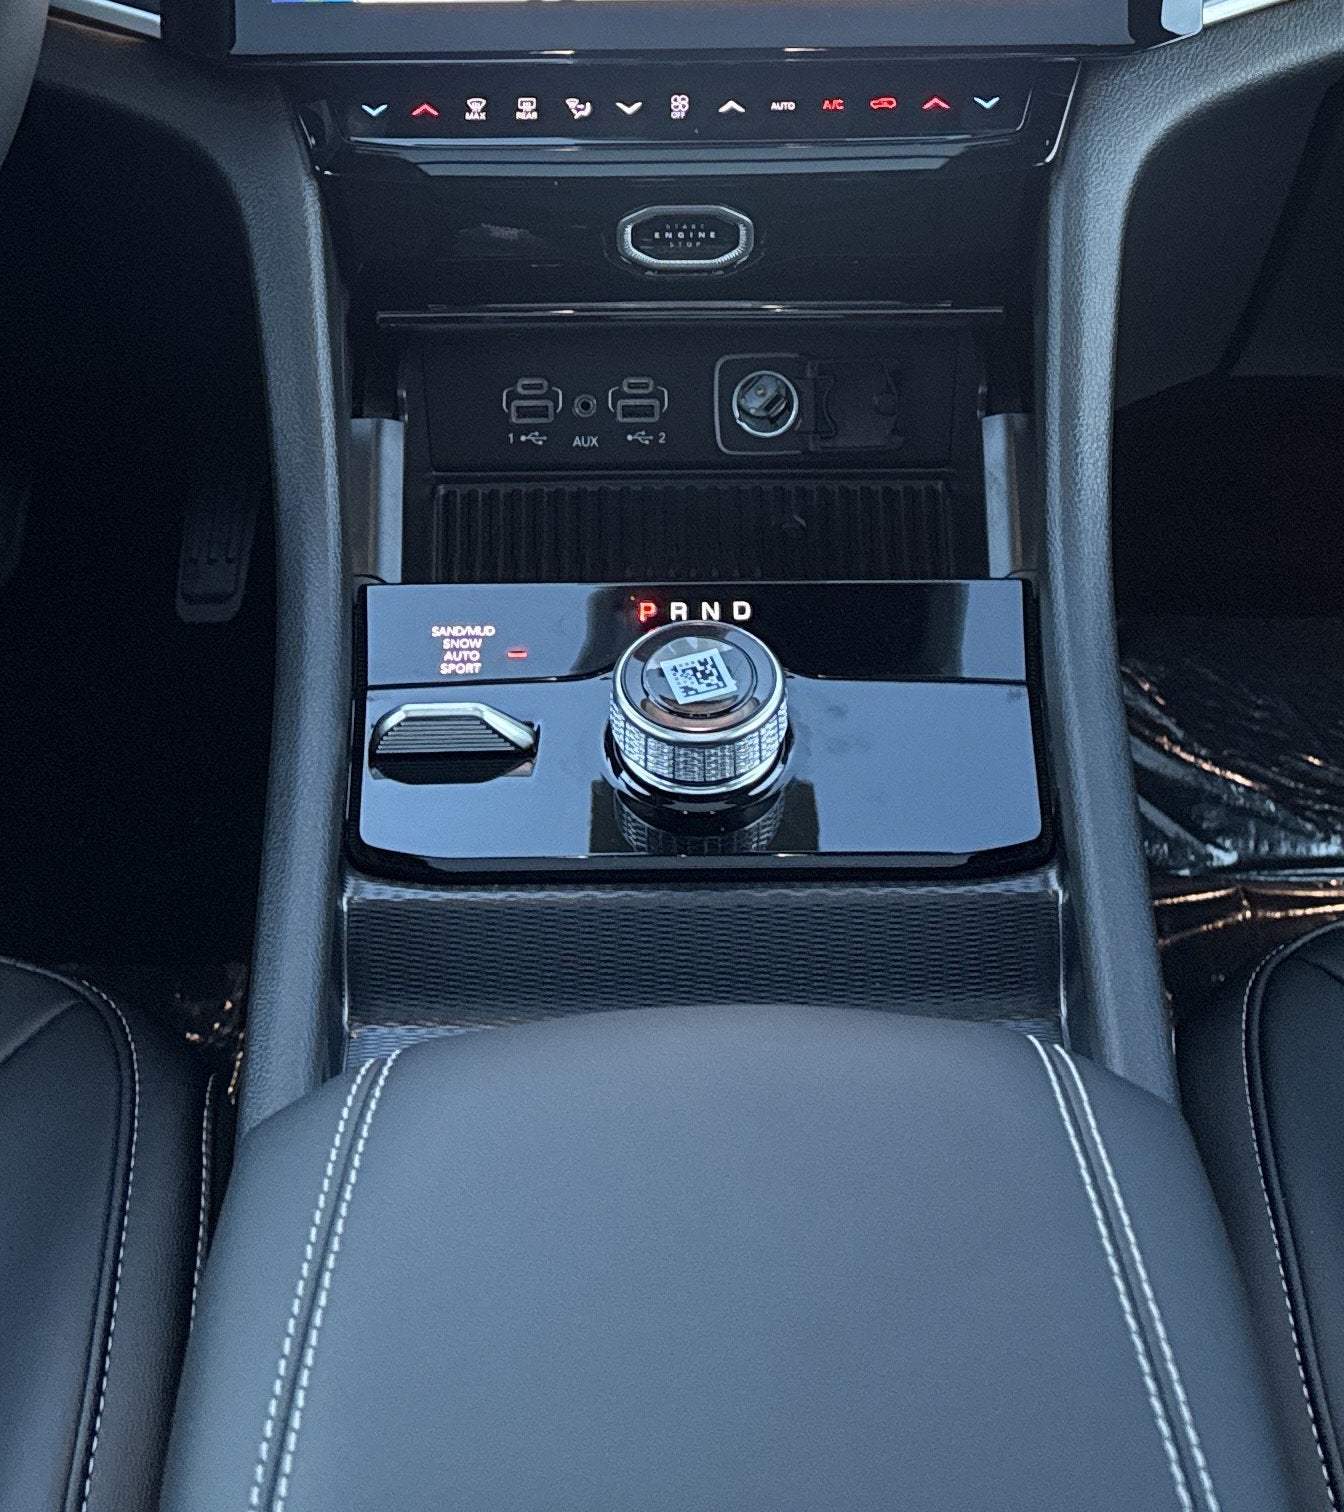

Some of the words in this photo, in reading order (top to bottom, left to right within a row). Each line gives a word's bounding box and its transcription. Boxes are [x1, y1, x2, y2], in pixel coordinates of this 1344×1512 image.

[770, 101, 796, 111] AUTO
[822, 98, 845, 110] A/C
[465, 112, 486, 121] MAX
[516, 111, 538, 120] REAR
[671, 111, 686, 119] OFF
[655, 231, 716, 239] ENGINE
[573, 436, 599, 448] AUX
[658, 432, 666, 443] 2
[639, 601, 657, 622] P
[670, 601, 687, 621] R
[701, 601, 720, 620] N
[733, 600, 752, 620] D
[431, 625, 496, 637] SAND/MUD
[442, 638, 483, 649] SNOW
[444, 650, 480, 662] AUTO
[440, 662, 482, 675] SPORT
